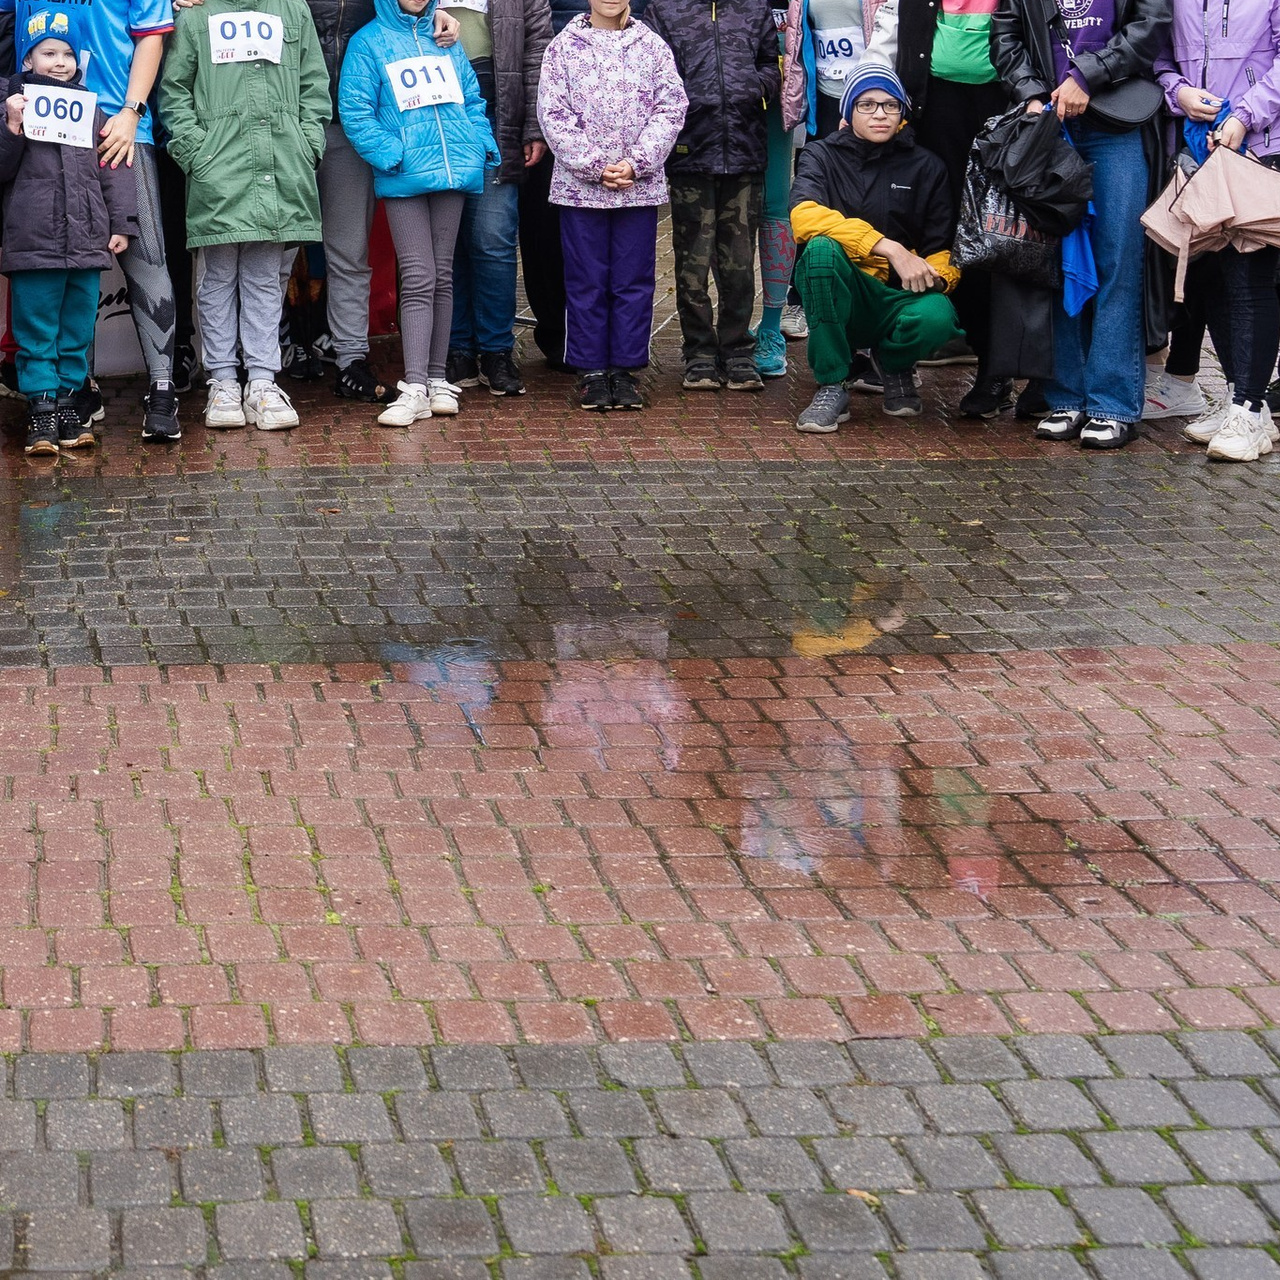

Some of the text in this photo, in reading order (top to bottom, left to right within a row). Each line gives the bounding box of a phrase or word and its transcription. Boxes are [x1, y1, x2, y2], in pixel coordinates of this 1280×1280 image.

[220, 20, 273, 40] 010
[818, 38, 853, 59] 049
[400, 65, 446, 89] 011
[34, 95, 83, 123] 060
